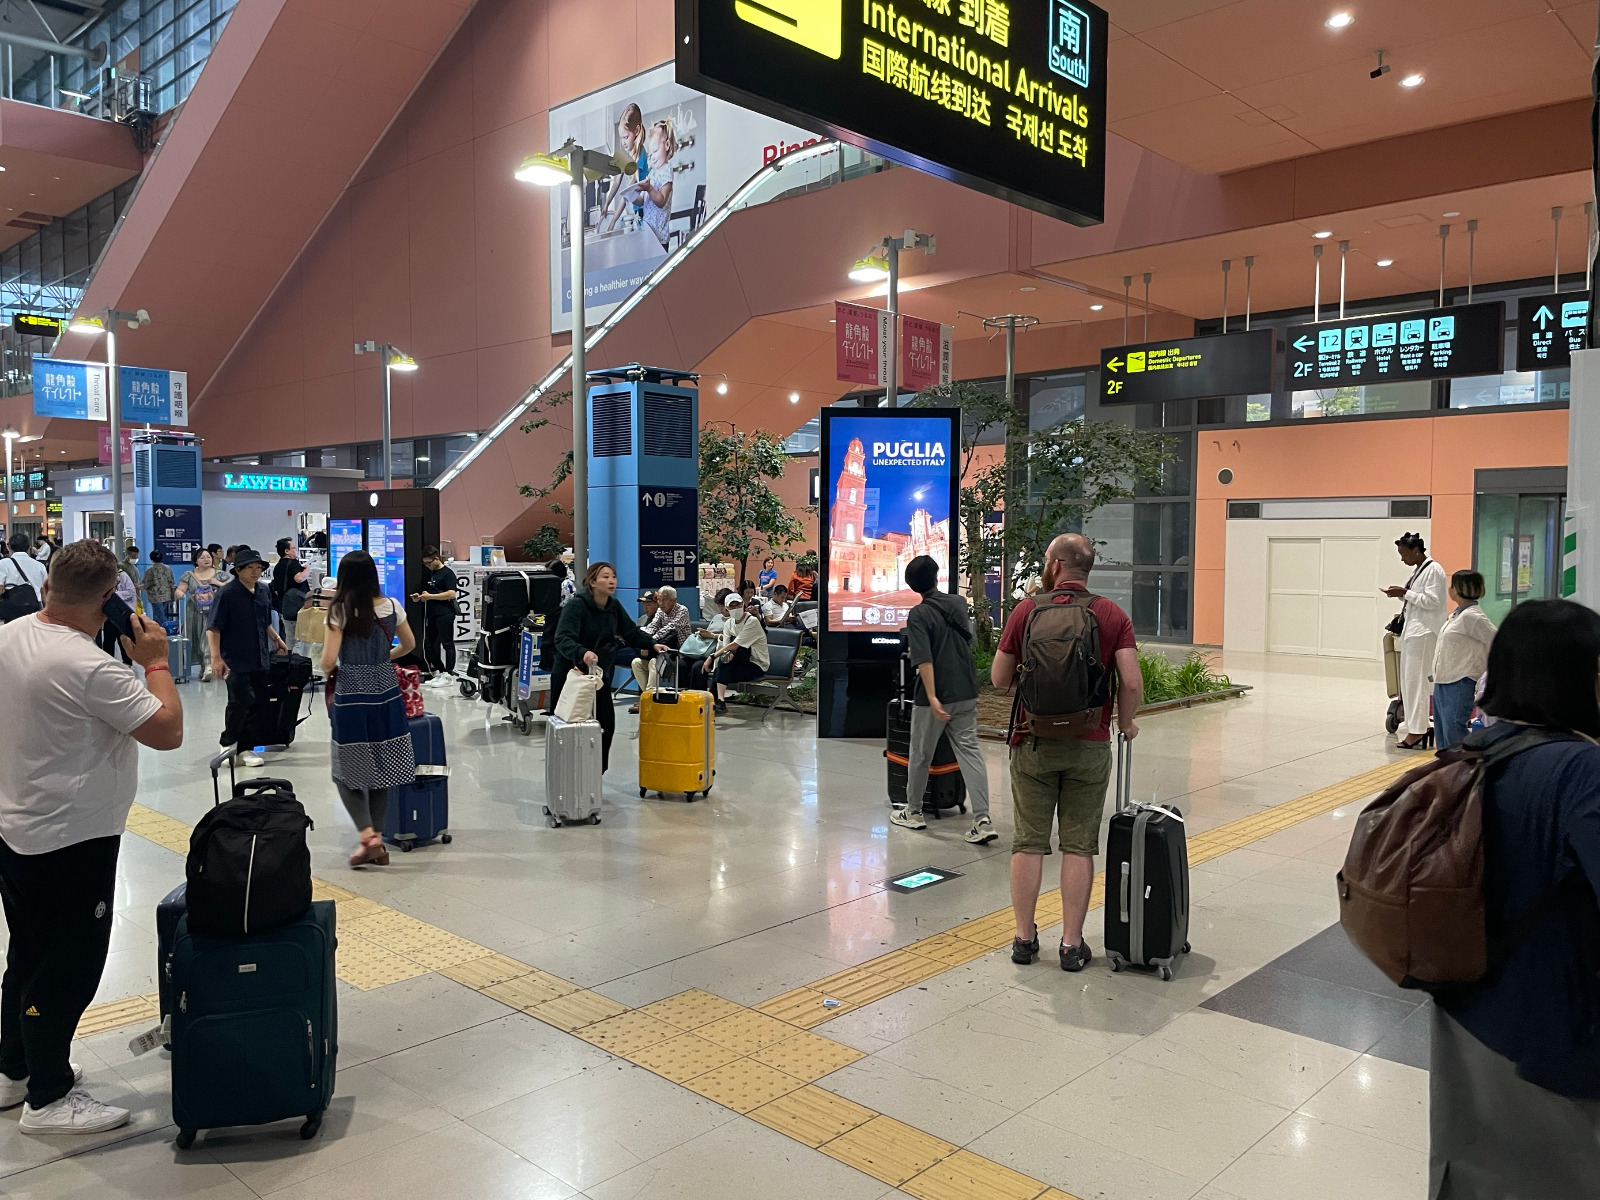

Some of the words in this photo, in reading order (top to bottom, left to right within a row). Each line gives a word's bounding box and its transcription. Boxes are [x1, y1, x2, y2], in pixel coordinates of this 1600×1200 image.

[1058, 8, 1081, 54] 南
[862, 0, 1011, 92] International
[1015, 67, 1088, 128] Arrivals
[1051, 45, 1086, 81] South
[1006, 104, 1054, 153] 국제선
[1057, 129, 1088, 168] 도착
[599, 277, 628, 294] healthier
[629, 275, 644, 287] way
[1321, 335, 1339, 347] T2
[1565, 328, 1585, 337] バス
[1400, 344, 1425, 353] レンタカー
[1148, 357, 1172, 365] Domestic
[1172, 354, 1202, 362] Departures
[1293, 361, 1313, 378] 2F
[1107, 380, 1124, 395] 2F
[873, 442, 946, 458] PUGLIA
[224, 473, 308, 492] LAWSON
[456, 576, 471, 638] GACHA
